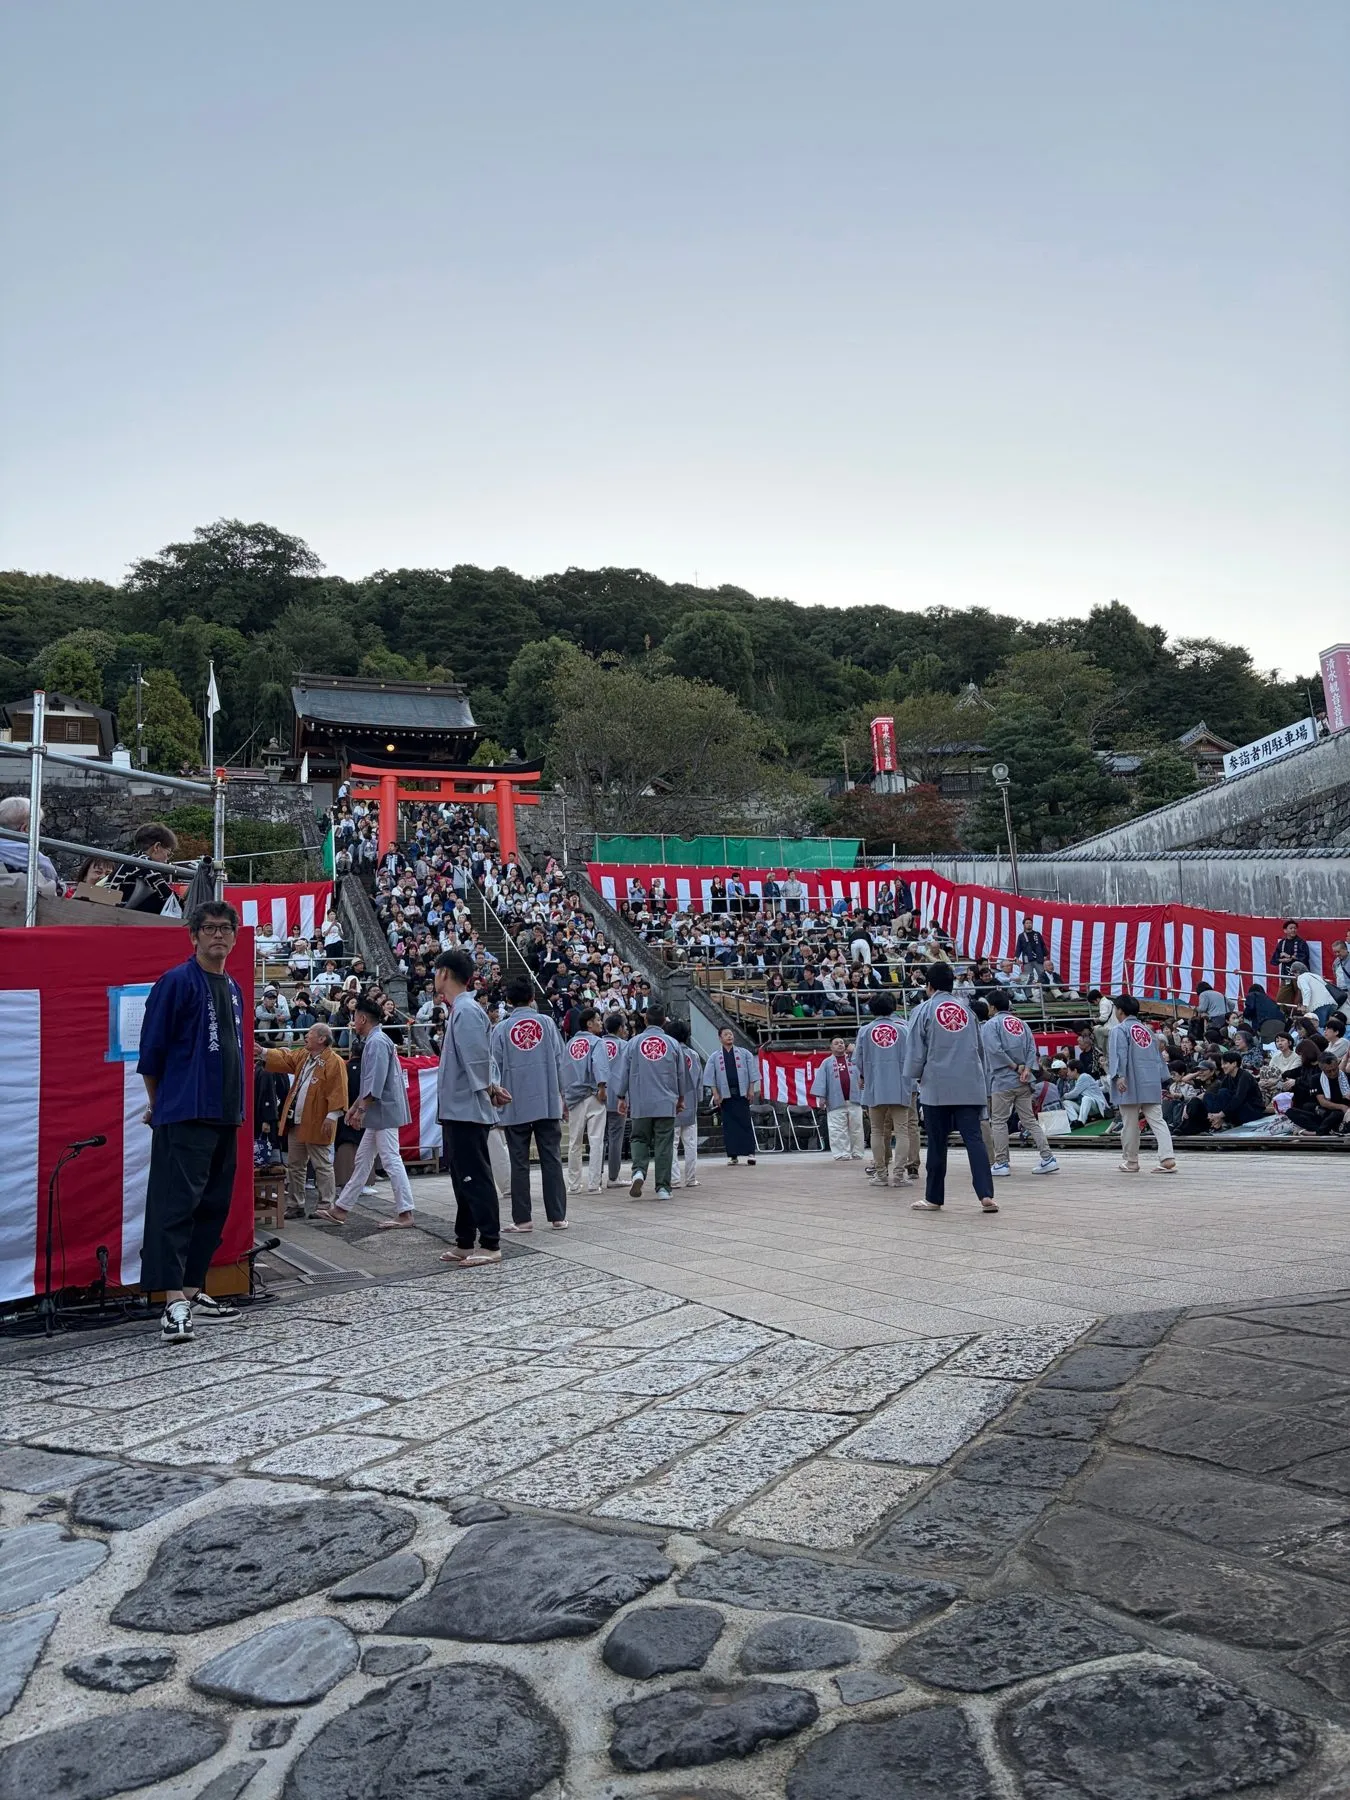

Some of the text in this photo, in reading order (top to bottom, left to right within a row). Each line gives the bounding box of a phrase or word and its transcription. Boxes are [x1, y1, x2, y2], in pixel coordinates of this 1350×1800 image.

[1229, 724, 1309, 772] 参詣者用駐車場
